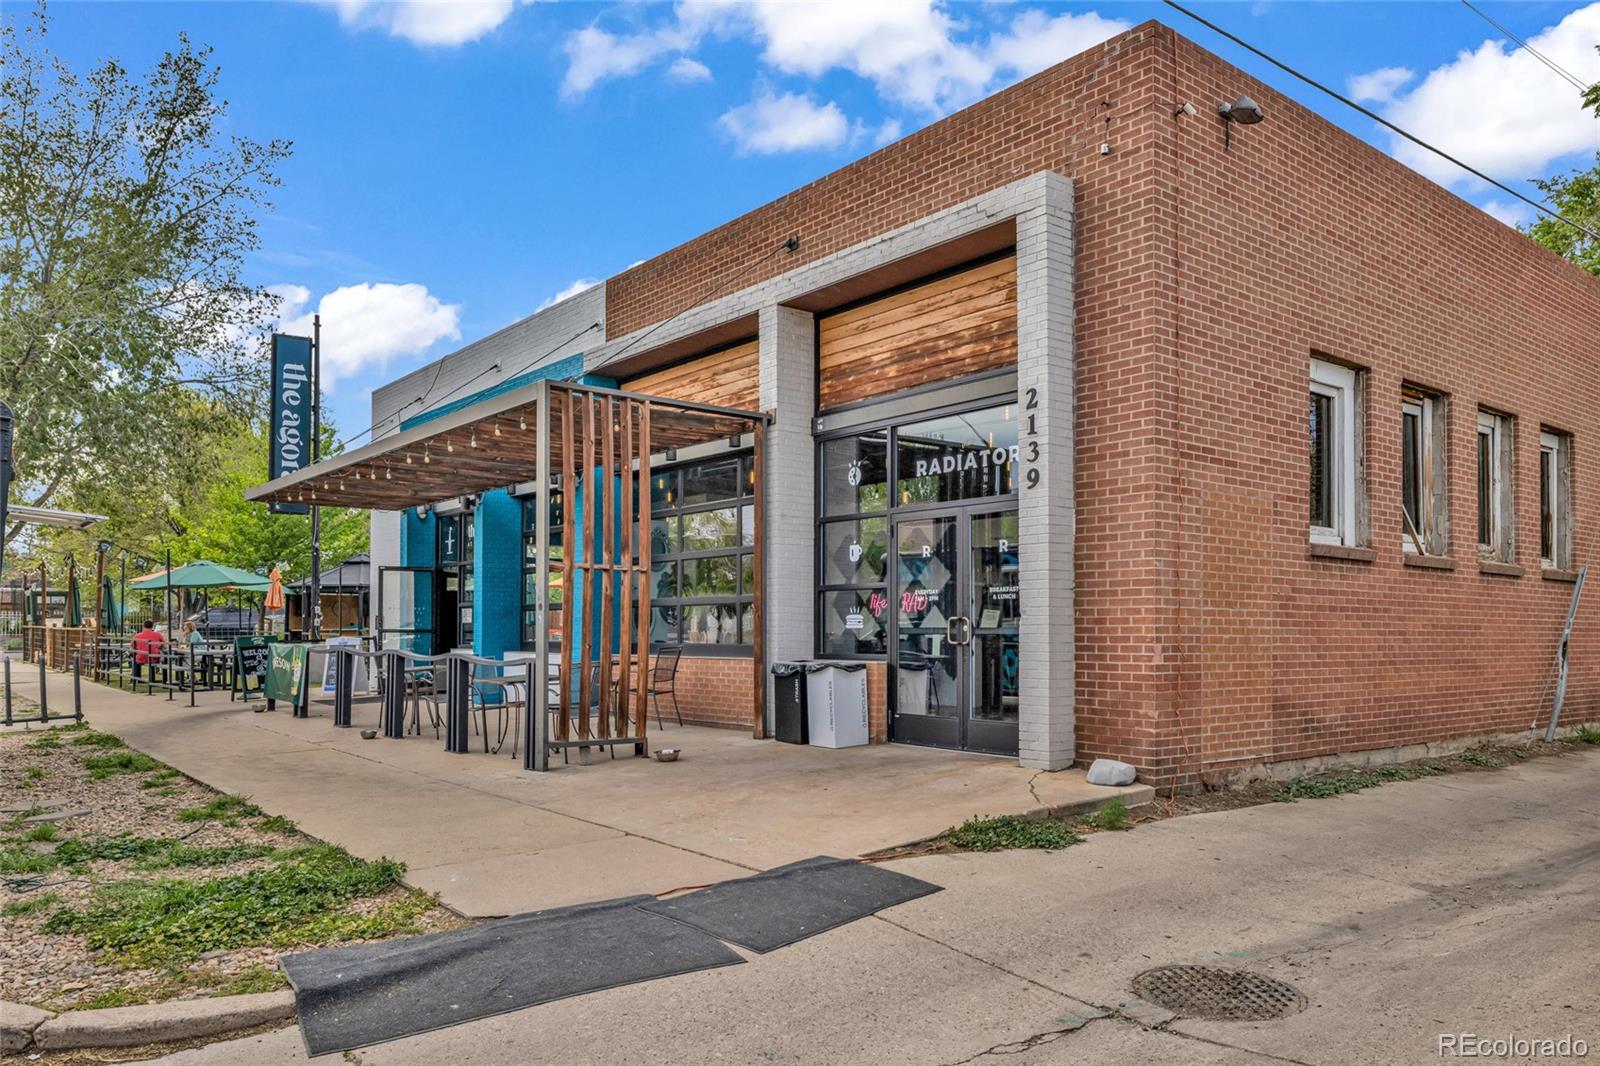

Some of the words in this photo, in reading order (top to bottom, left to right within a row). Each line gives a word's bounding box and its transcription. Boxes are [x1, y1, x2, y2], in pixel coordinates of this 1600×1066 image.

[282, 363, 308, 406] the
[1025, 387, 1040, 490] 2139
[916, 445, 1019, 477] RADIATOR
[922, 545, 931, 557] R
[999, 540, 1008, 552] R
[243, 649, 269, 657] WELCO
